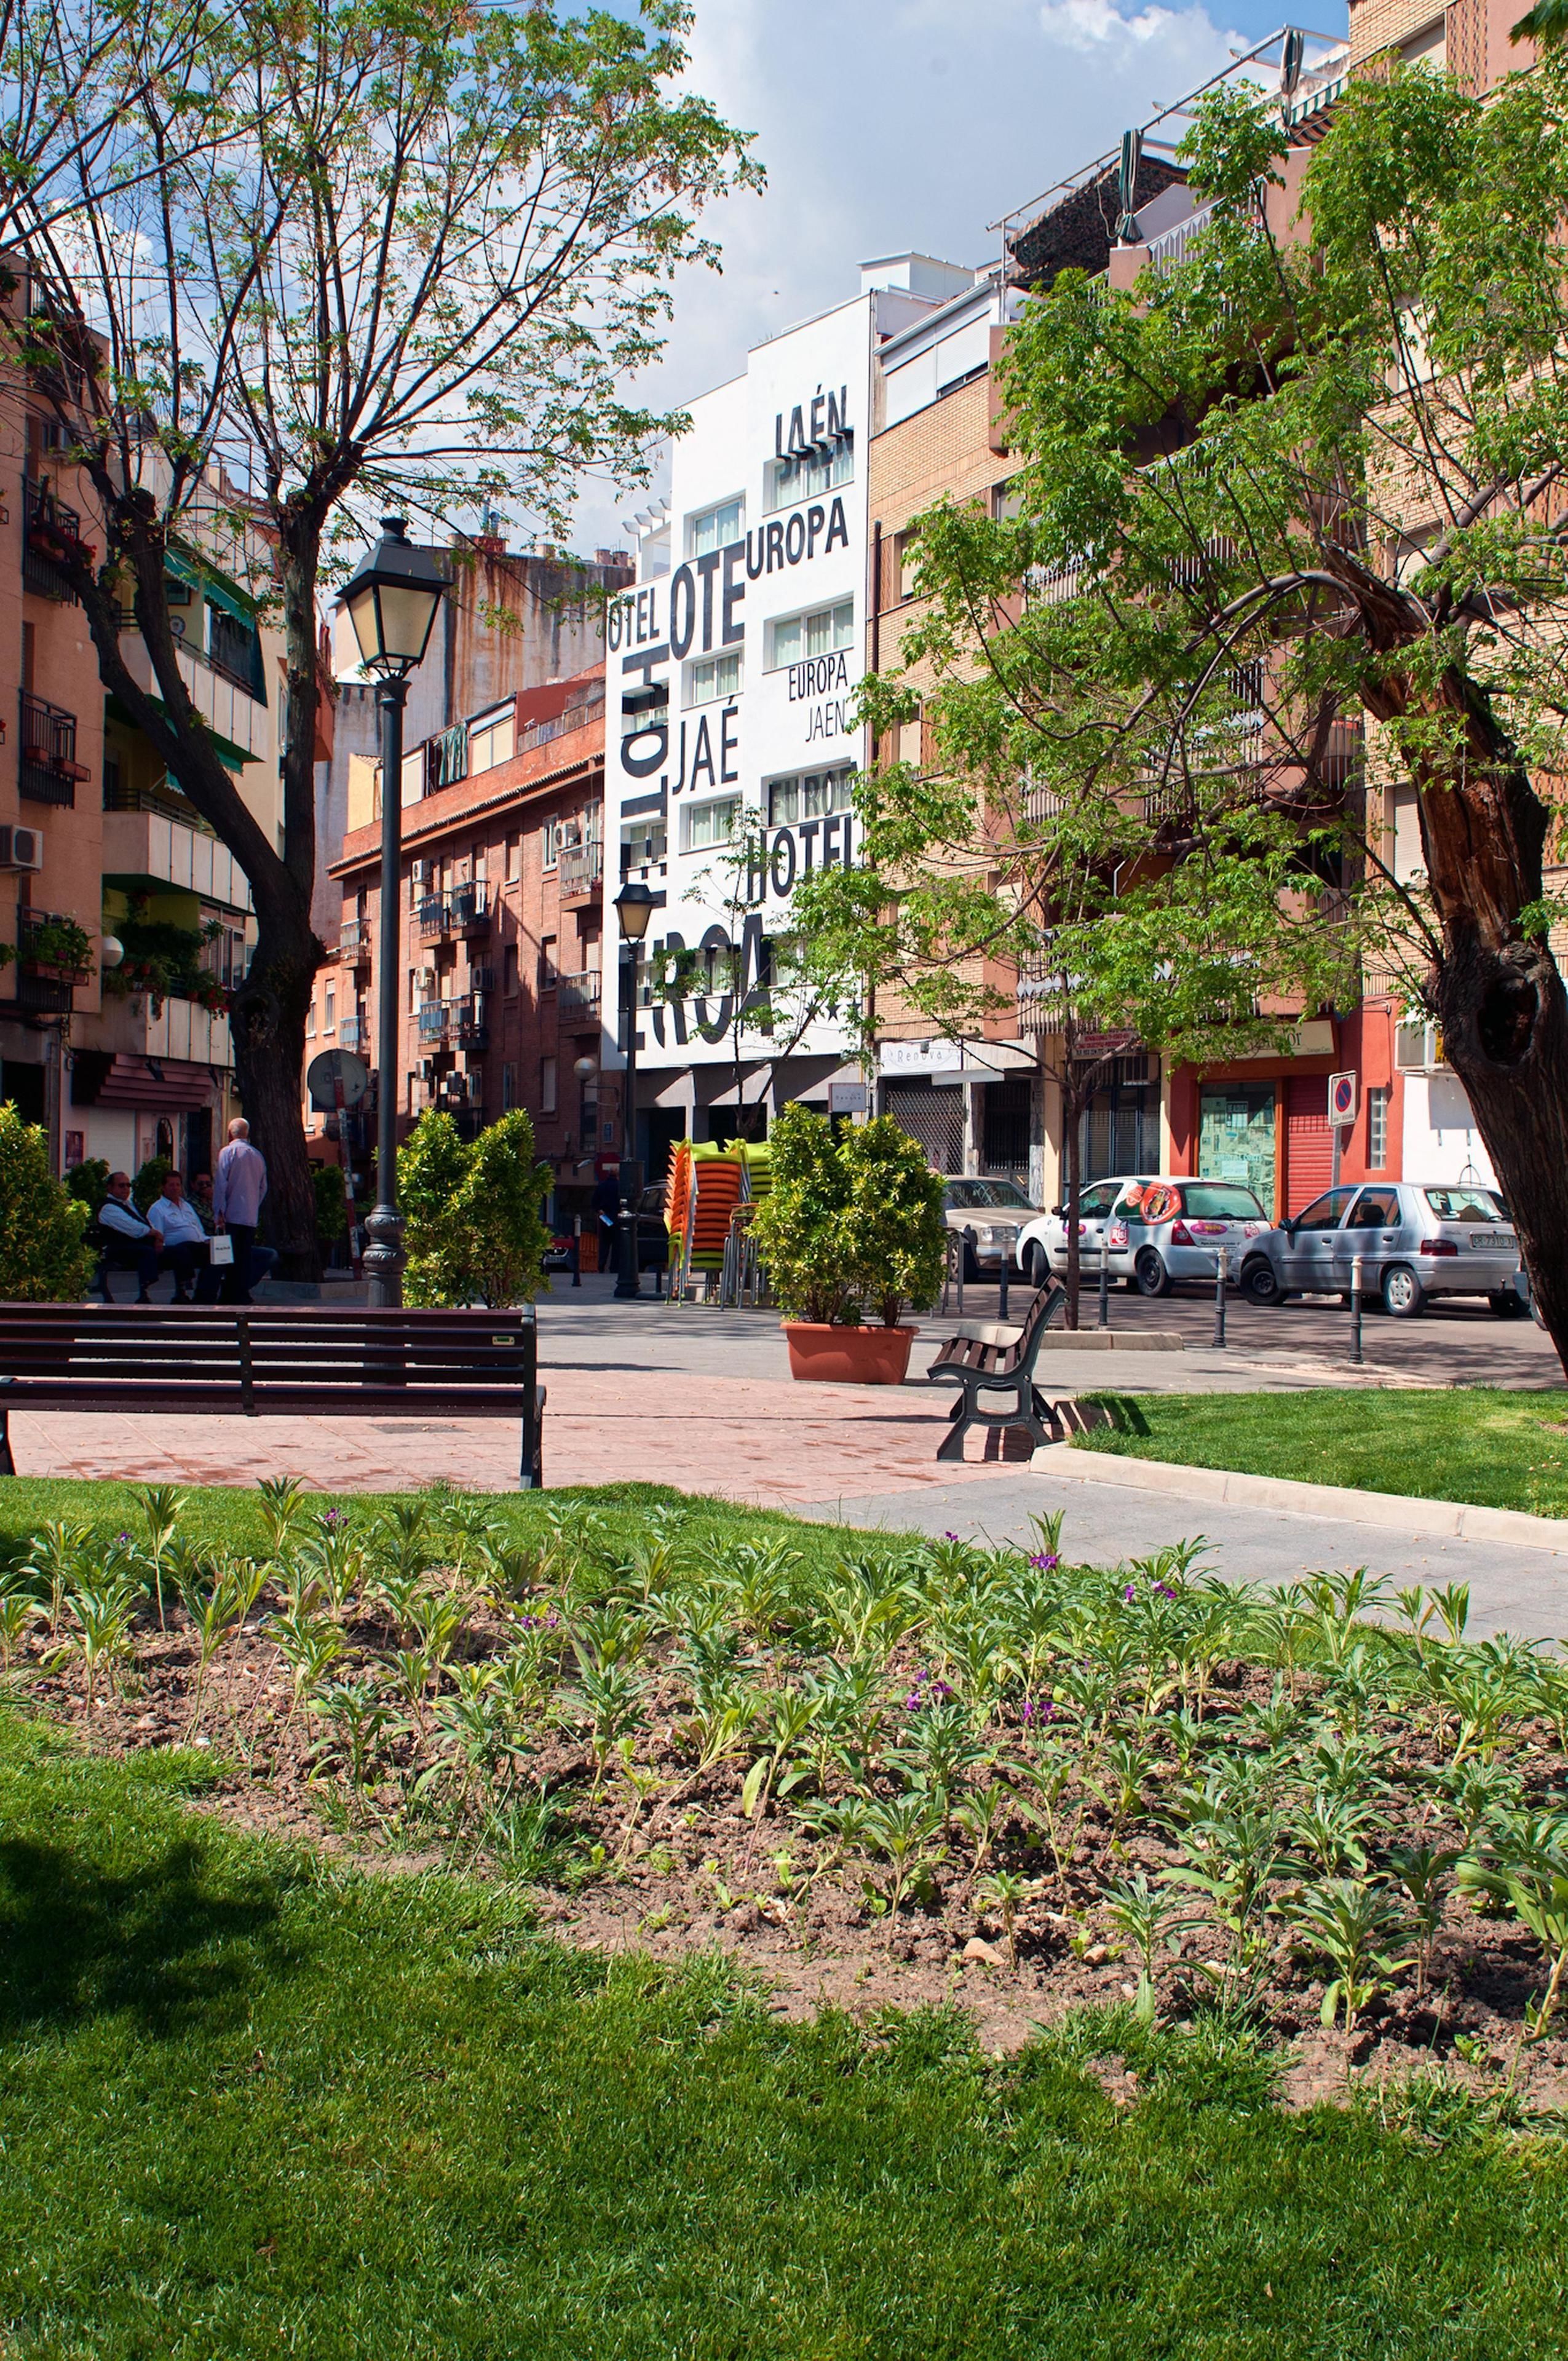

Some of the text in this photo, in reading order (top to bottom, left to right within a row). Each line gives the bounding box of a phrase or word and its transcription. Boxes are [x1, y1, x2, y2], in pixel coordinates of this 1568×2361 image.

[746, 497, 849, 580] UROPA
[608, 587, 660, 652] OTEL
[789, 653, 848, 702] EUROPA
[672, 695, 738, 795] JAÉ
[805, 697, 845, 743] JAÉN
